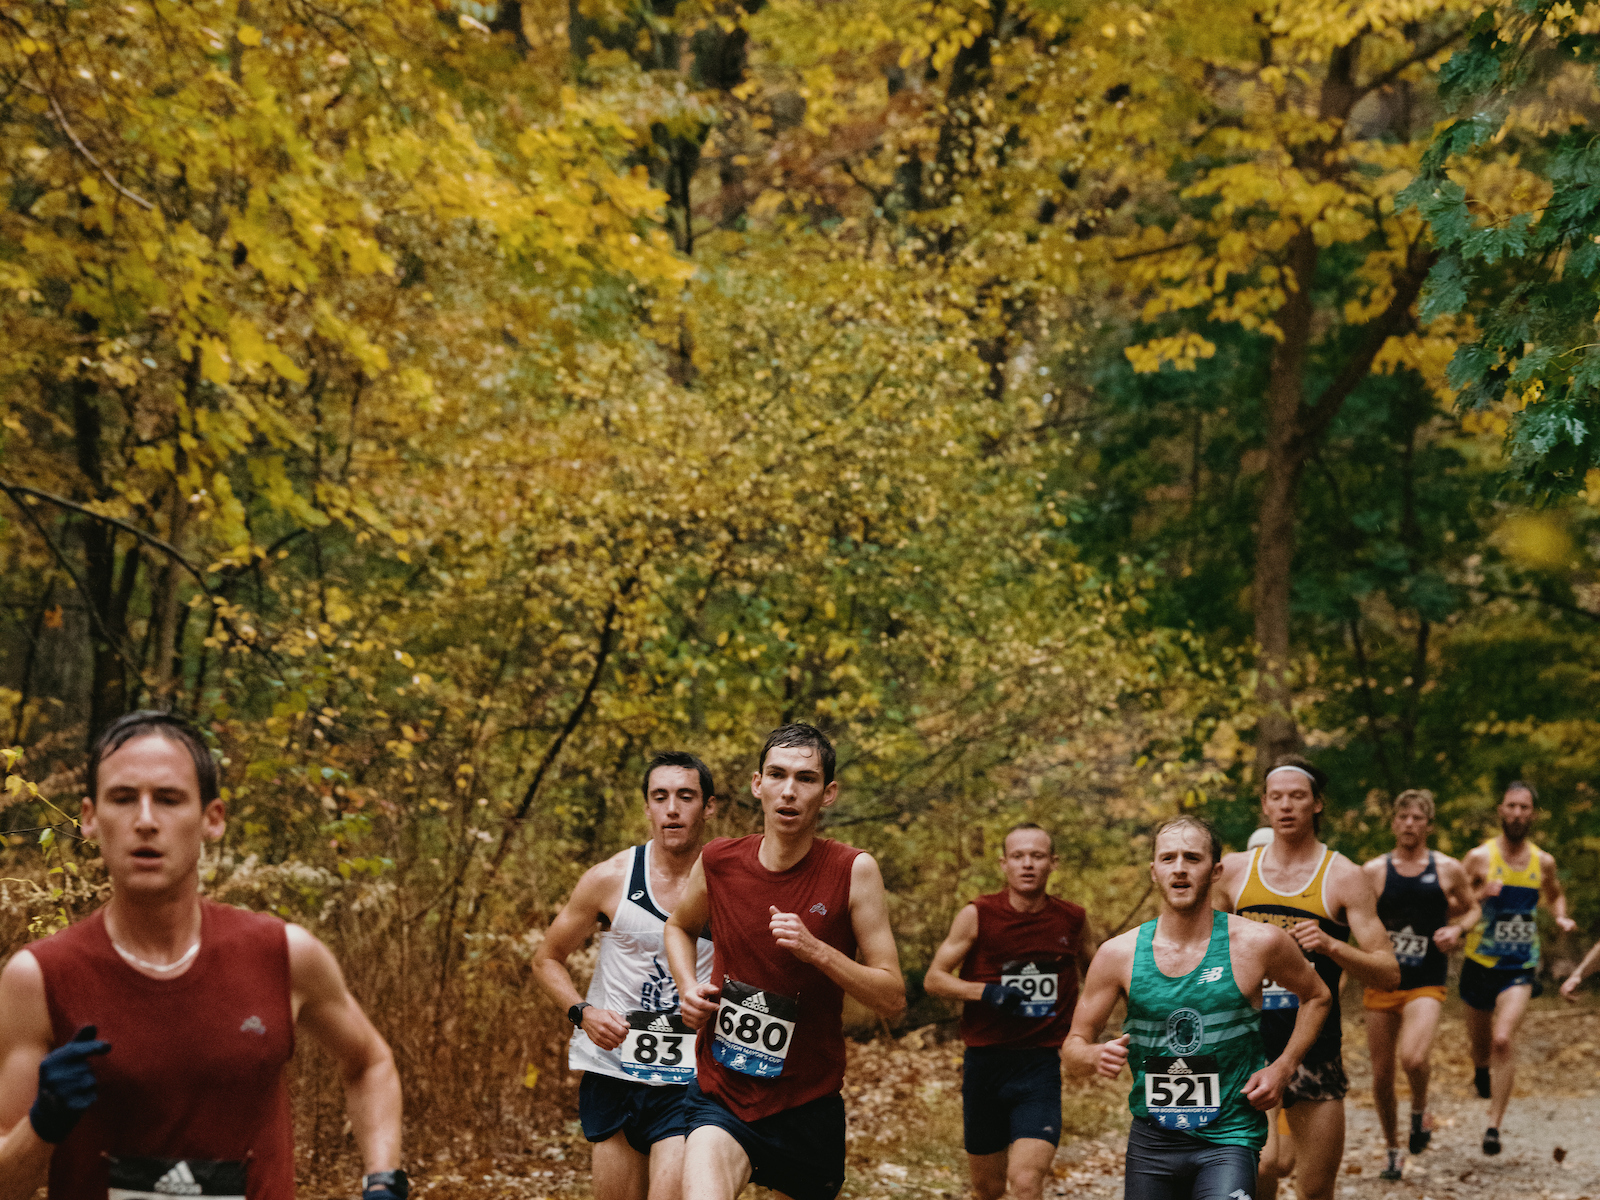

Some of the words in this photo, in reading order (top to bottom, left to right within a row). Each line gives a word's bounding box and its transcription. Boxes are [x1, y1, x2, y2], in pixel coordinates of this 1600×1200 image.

[1498, 923, 1533, 940] 555
[1389, 934, 1424, 955] 573
[741, 1000, 770, 1014] adidas
[647, 1025, 674, 1033] adidas
[719, 1005, 788, 1052] 680
[633, 1033, 684, 1066] 83
[1150, 1076, 1213, 1107] 521
